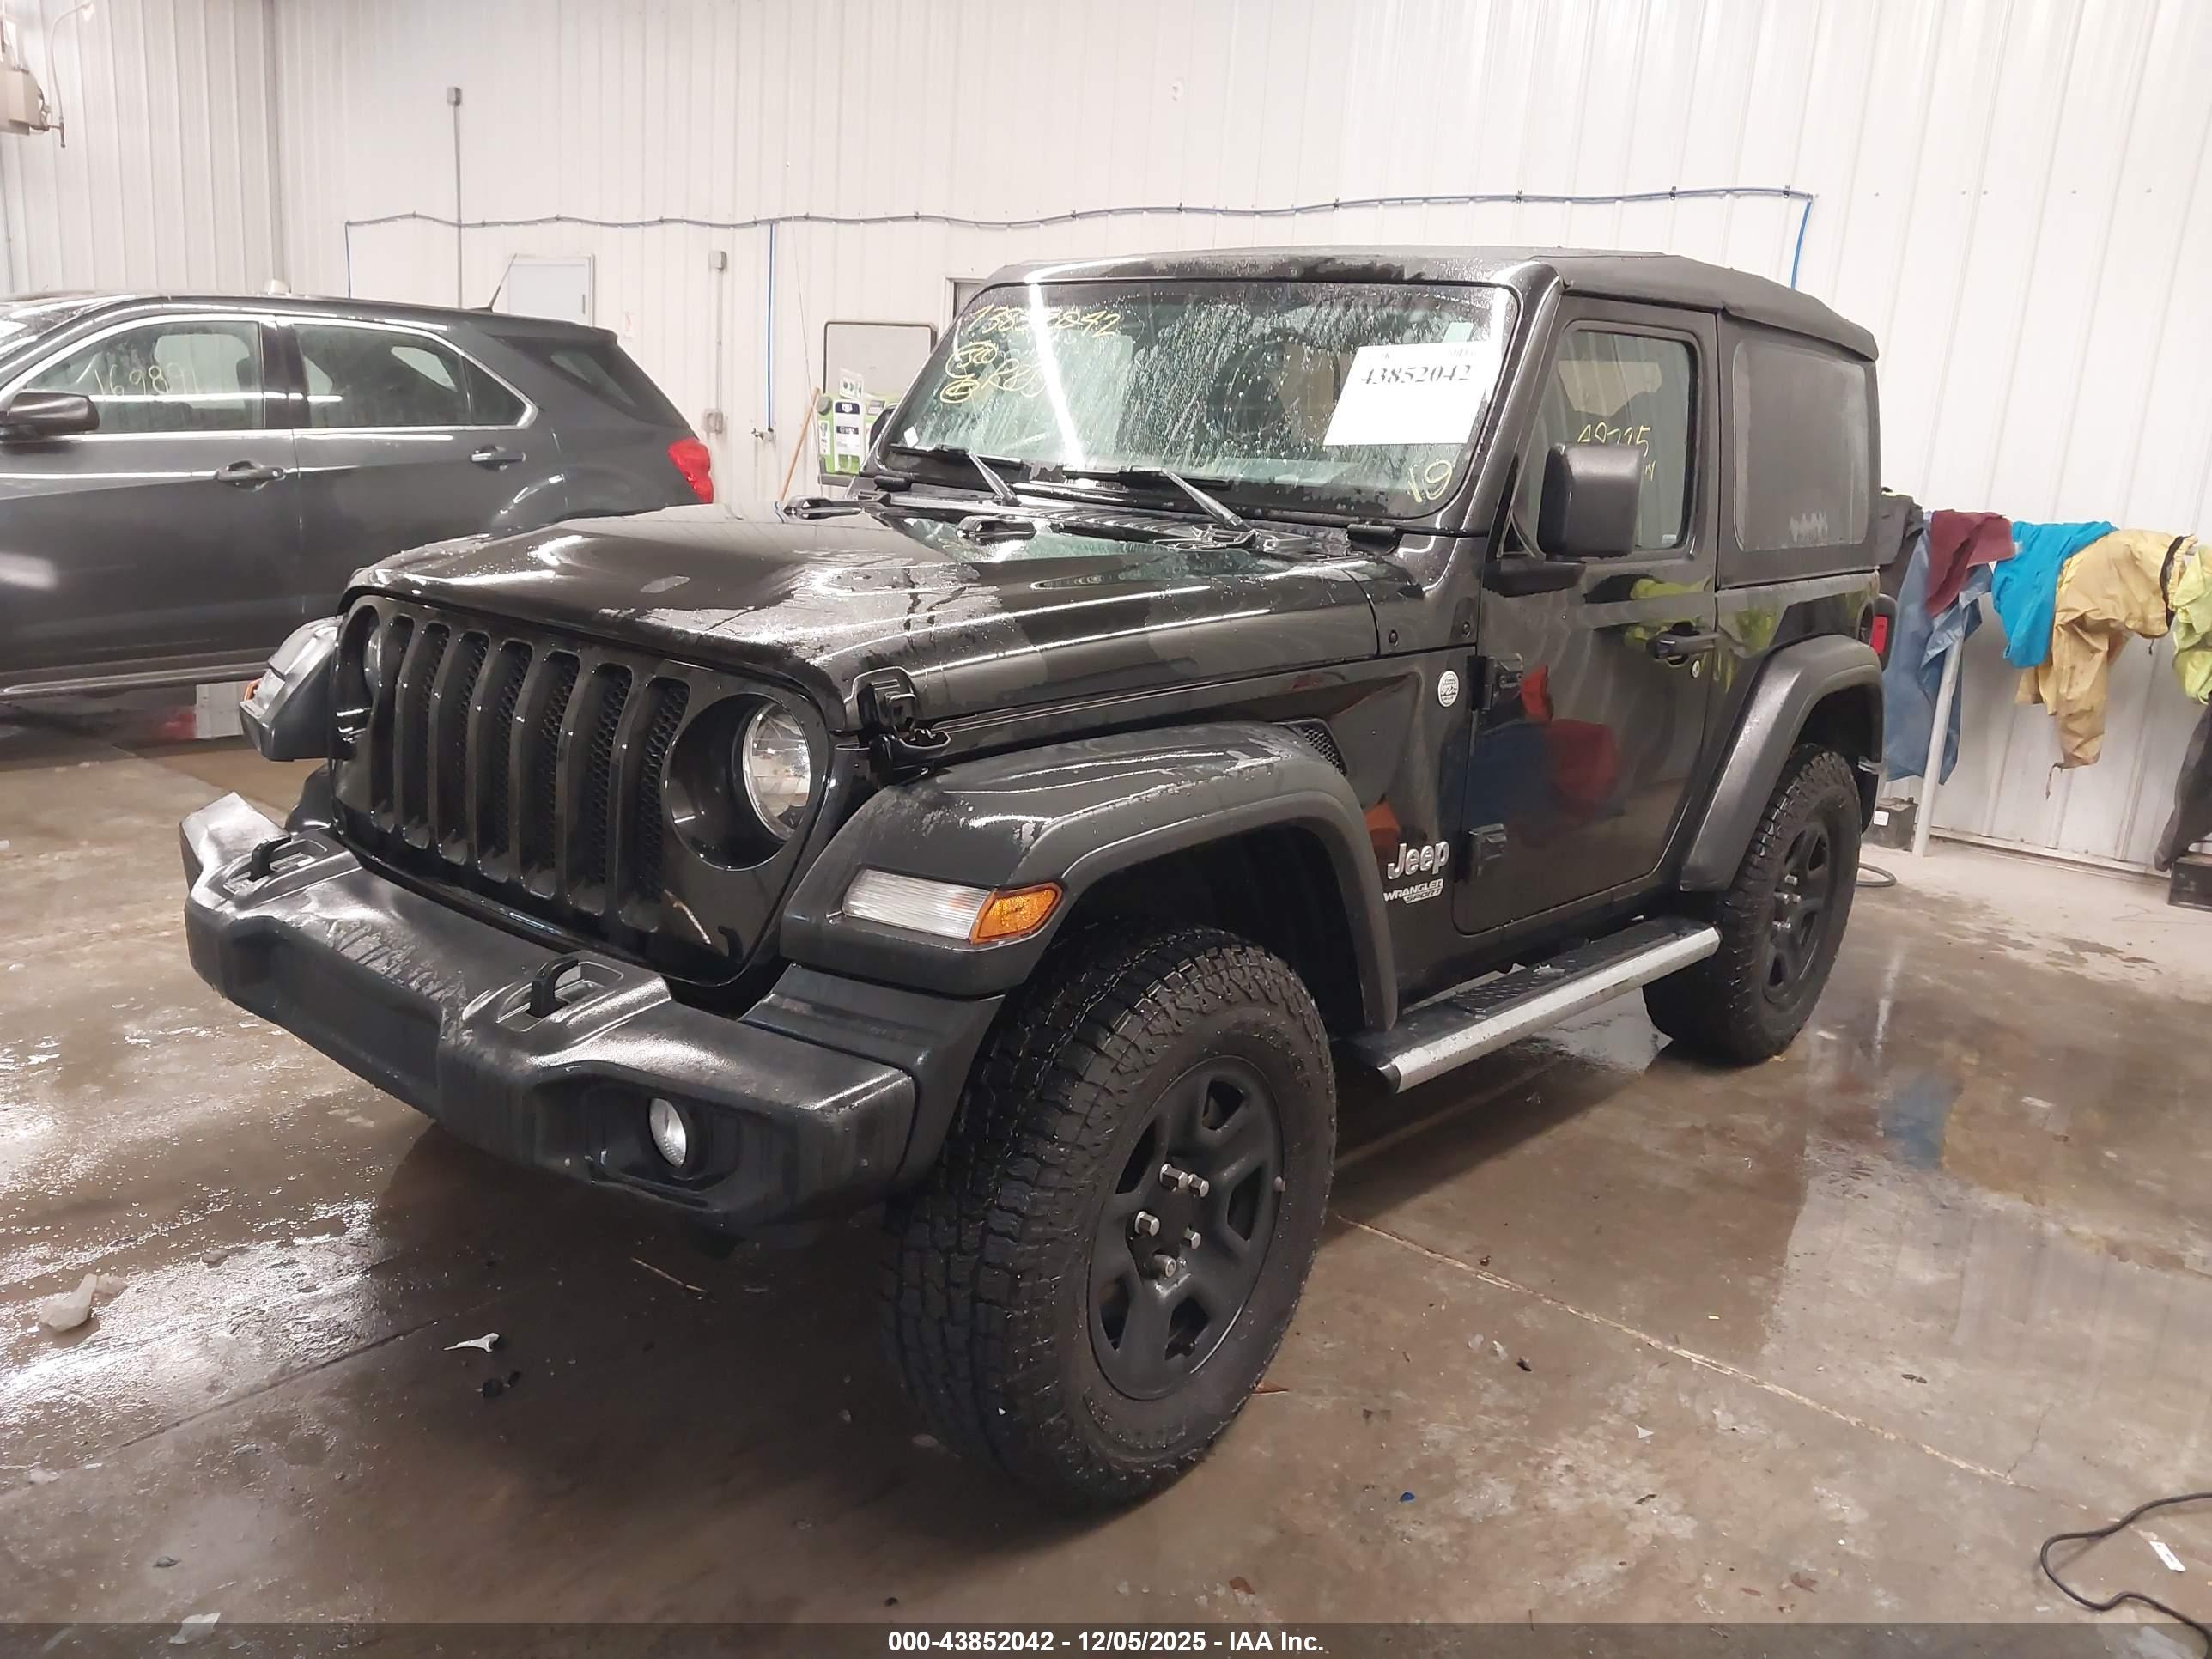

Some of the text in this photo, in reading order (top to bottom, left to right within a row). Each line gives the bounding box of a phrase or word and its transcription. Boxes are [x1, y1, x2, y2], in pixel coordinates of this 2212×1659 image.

[1360, 364, 1471, 384] 43852042
[1407, 460, 1453, 502] 19
[1387, 841, 1450, 880] Jeep
[1383, 878, 1443, 902] WRANGLER
